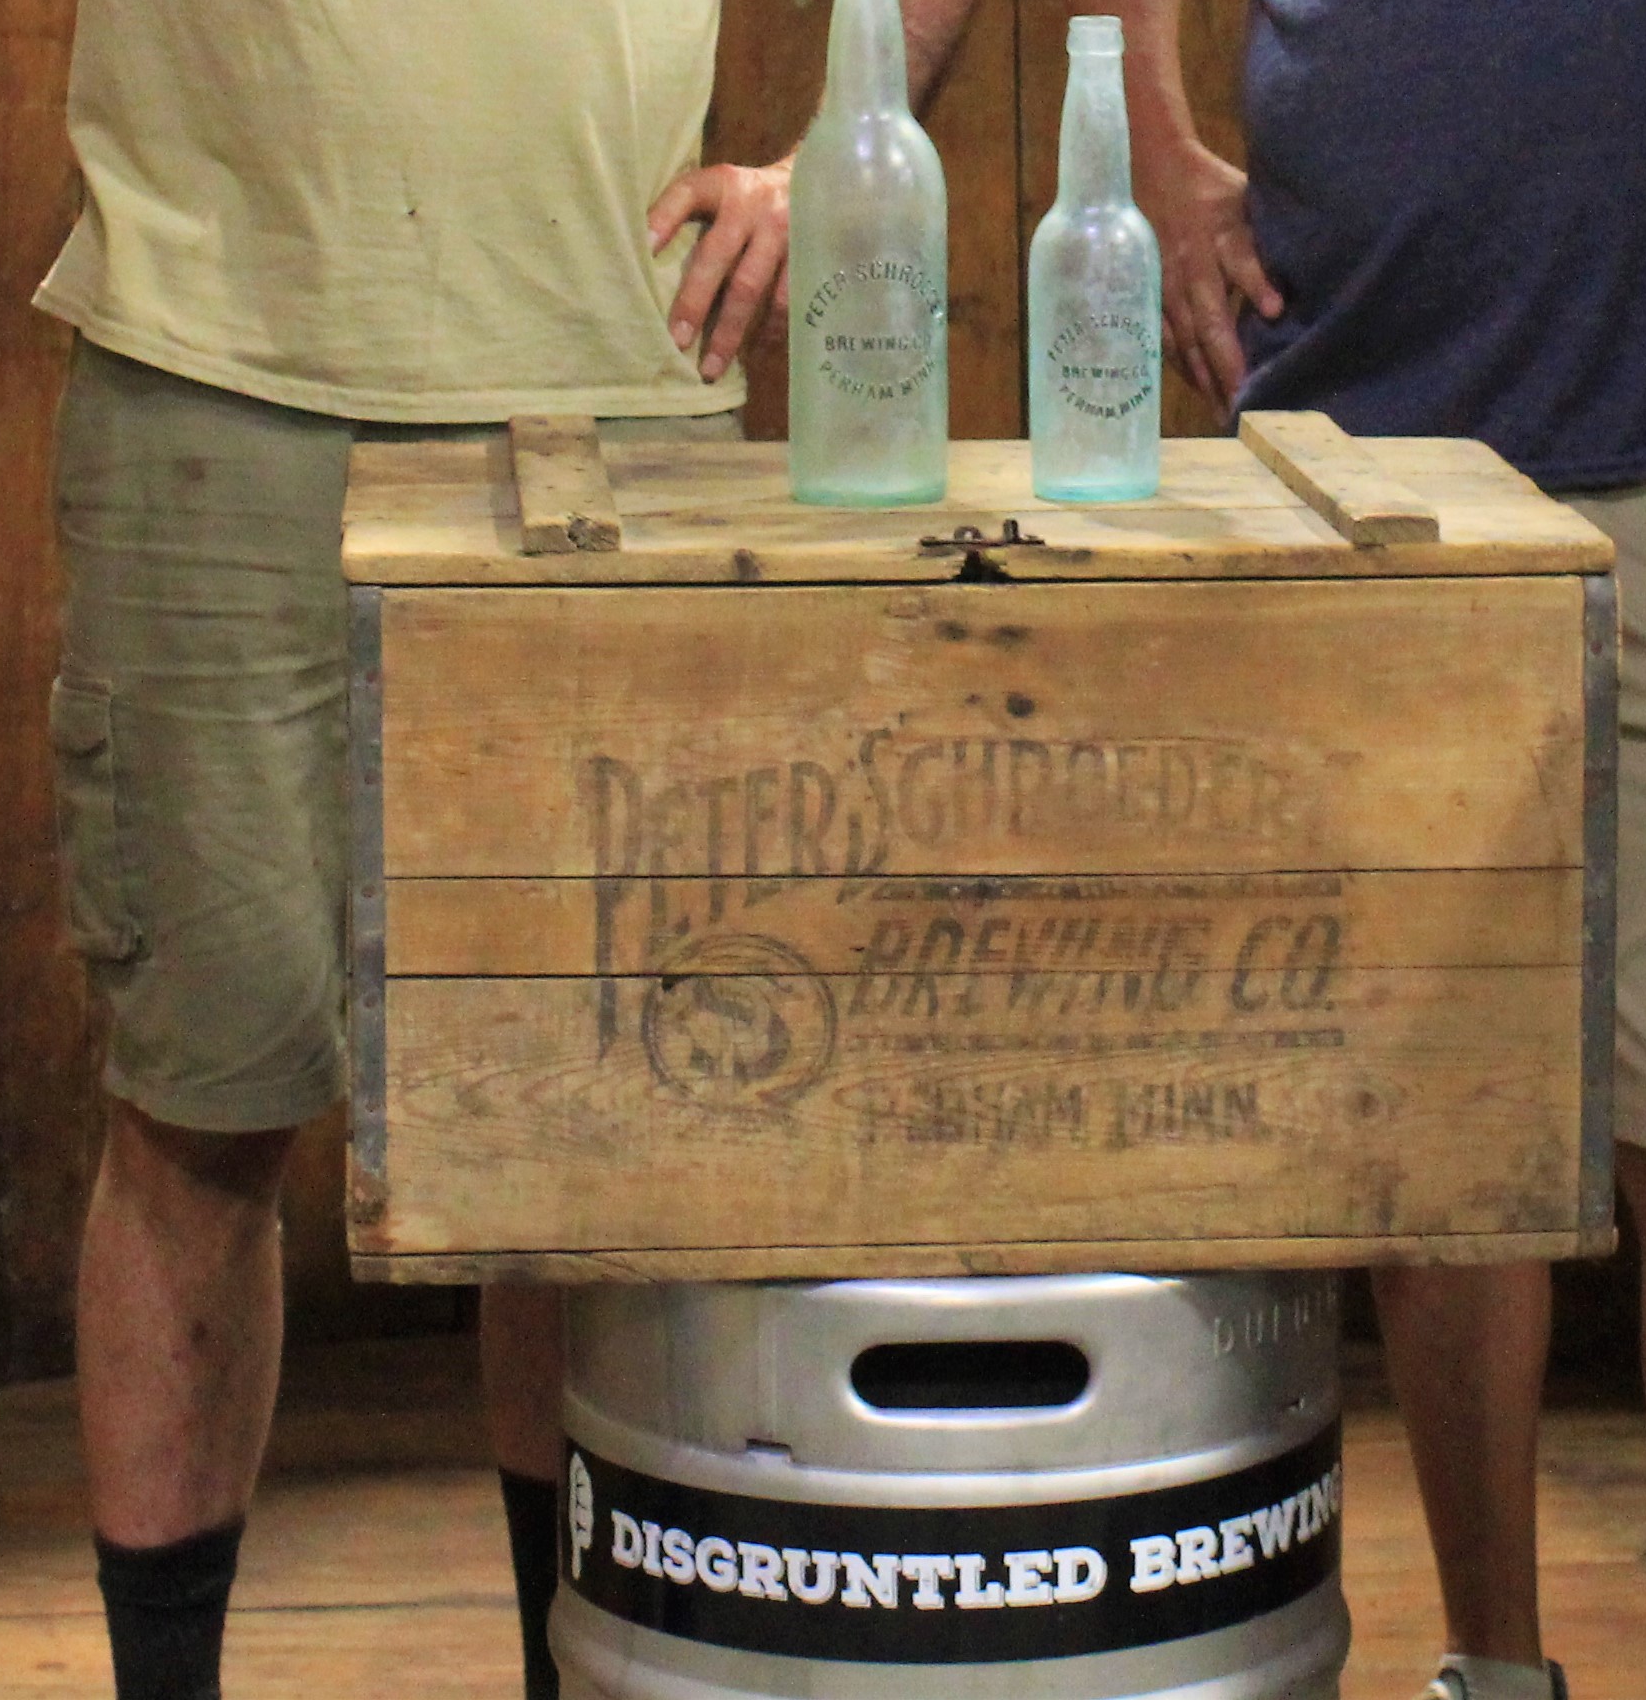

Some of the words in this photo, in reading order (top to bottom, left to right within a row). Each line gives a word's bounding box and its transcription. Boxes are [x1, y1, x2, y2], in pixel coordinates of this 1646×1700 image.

[805, 270, 848, 328] PETER
[825, 334, 908, 351] BREWING
[847, 910, 1215, 1018] BREWING
[611, 1508, 1107, 1610] DISGRUNTLED
